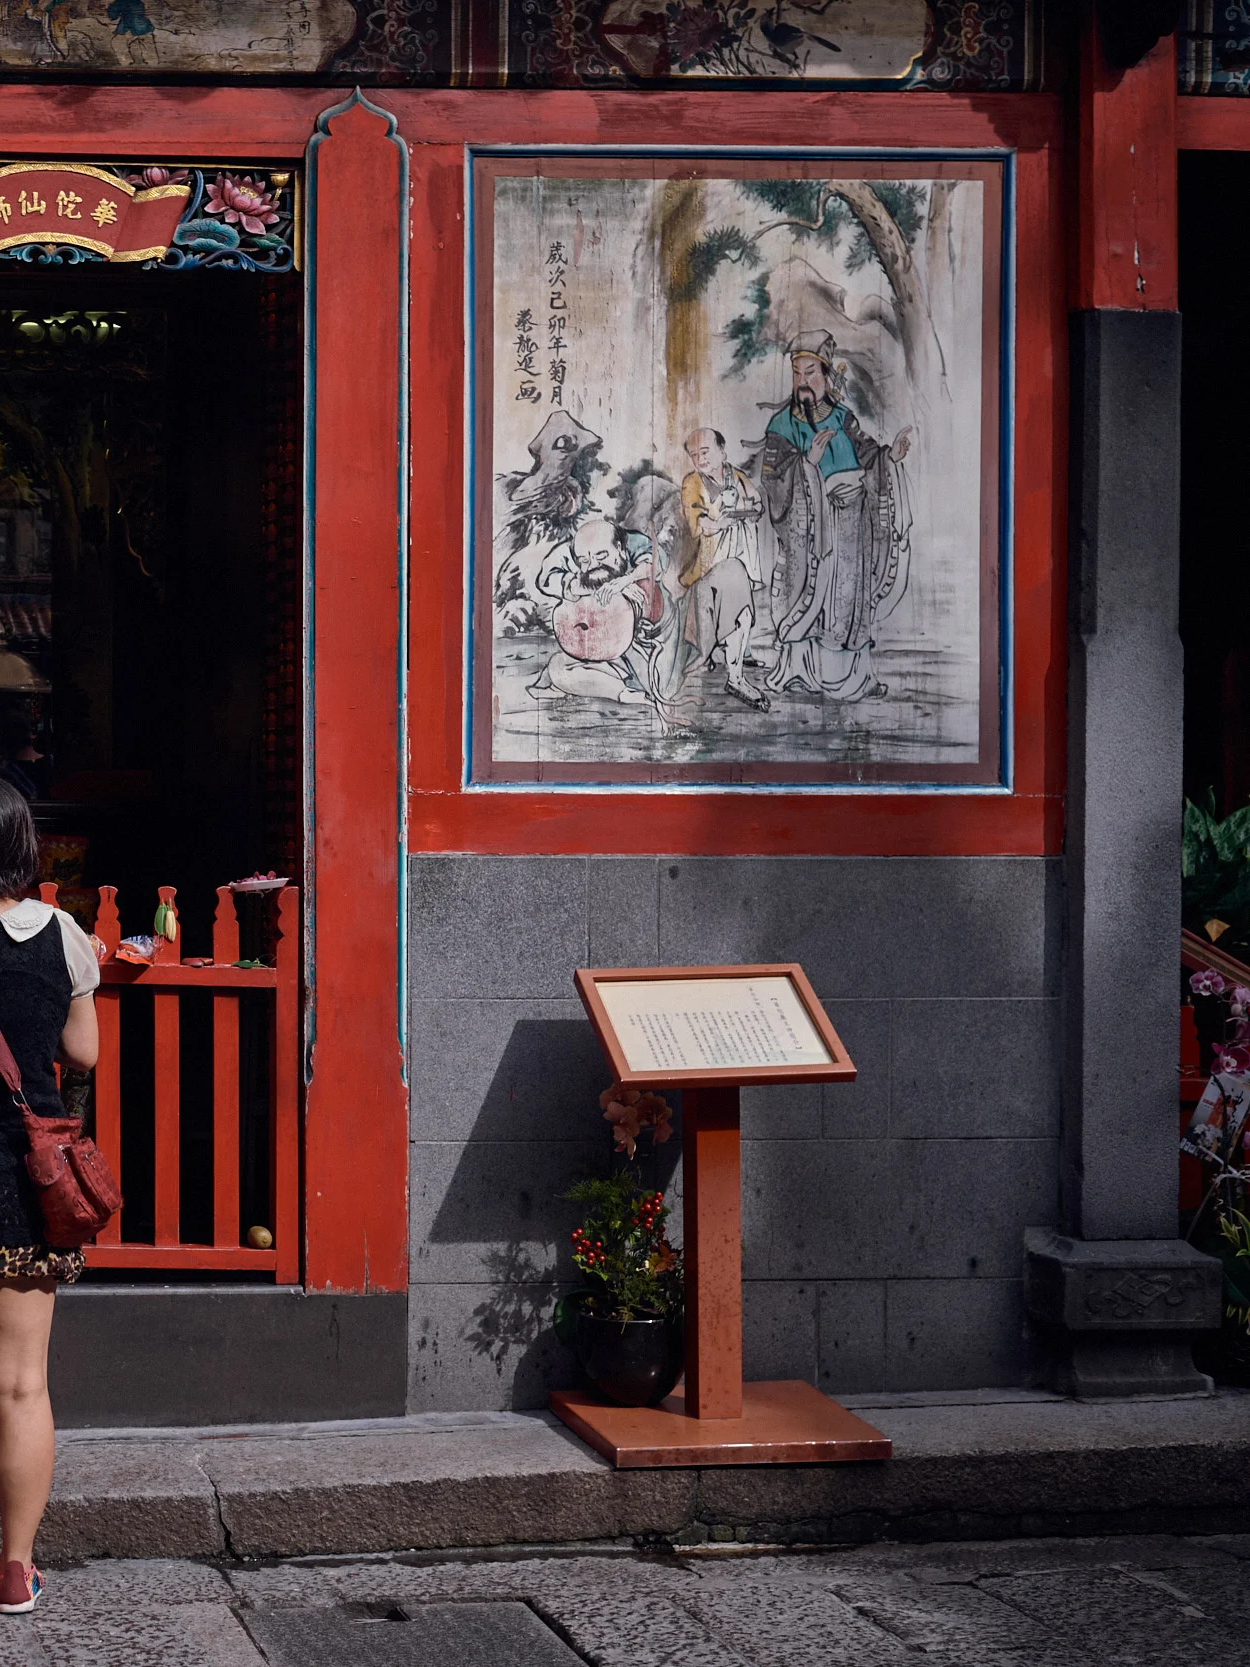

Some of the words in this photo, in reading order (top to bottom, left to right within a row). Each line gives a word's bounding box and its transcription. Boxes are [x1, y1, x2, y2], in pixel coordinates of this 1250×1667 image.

[545, 241, 568, 406] 歲次己卯年菊月
